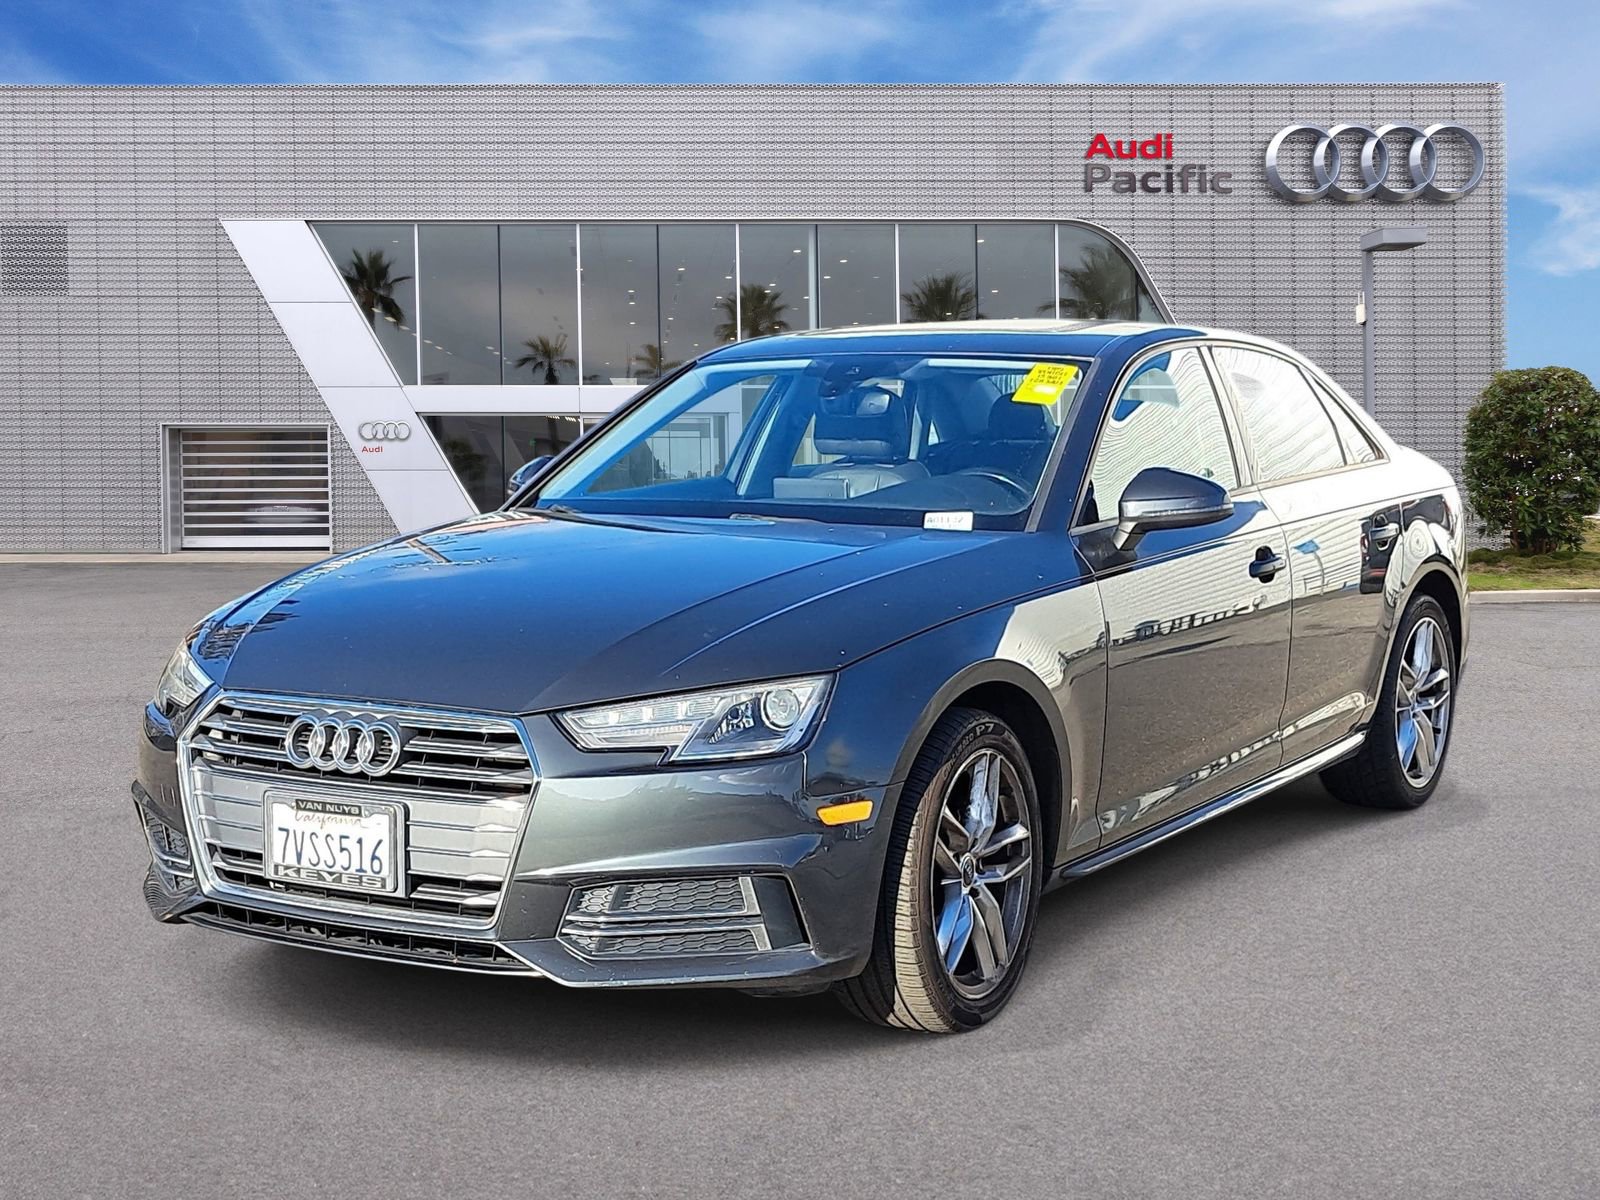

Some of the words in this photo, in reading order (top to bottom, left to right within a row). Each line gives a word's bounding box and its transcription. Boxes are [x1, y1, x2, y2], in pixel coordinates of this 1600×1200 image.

[1084, 132, 1174, 159] Audi
[1084, 163, 1232, 194] Pacific
[975, 723, 994, 736] P7
[297, 801, 323, 811] VAN
[325, 803, 360, 815] NUYS
[278, 827, 383, 875] 7VSS516
[278, 866, 383, 889] KEYES
